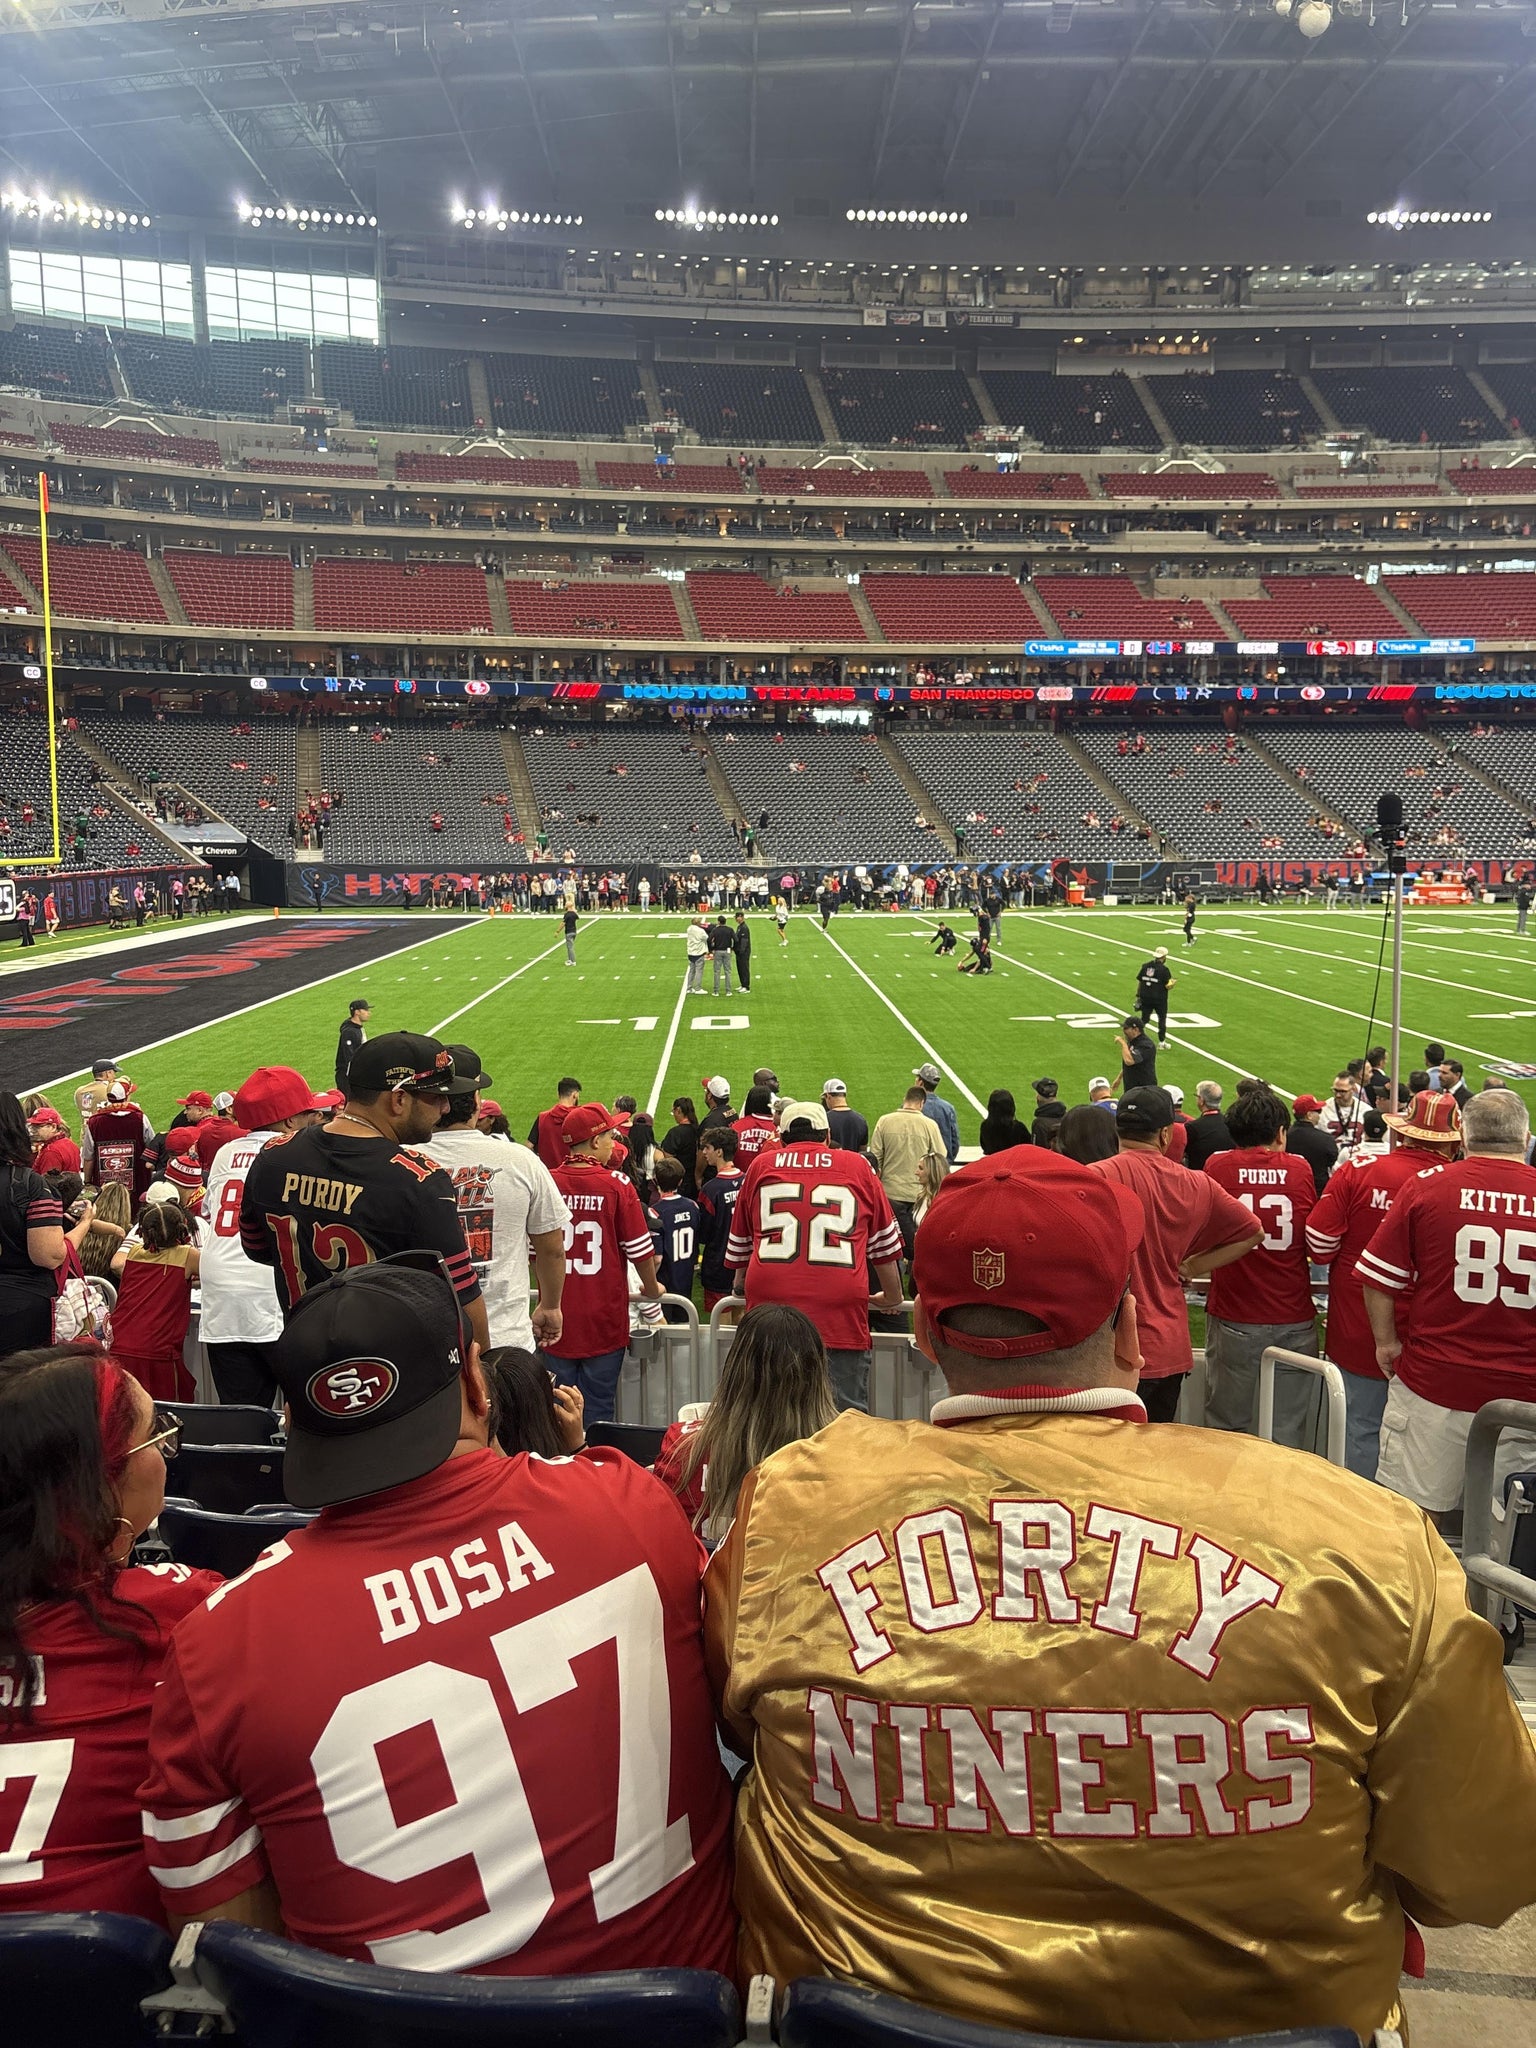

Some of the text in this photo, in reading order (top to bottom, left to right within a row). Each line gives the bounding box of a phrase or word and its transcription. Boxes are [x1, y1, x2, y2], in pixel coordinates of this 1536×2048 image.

[623, 685, 856, 700] HOUSTON TEXANS
[910, 688, 942, 700] SAN
[945, 688, 1035, 700] FRANCISCO
[1435, 685, 1536, 699] HOUSTO
[205, 846, 237, 855] Chevron
[231, 1152, 257, 1169] KIT
[740, 1141, 758, 1152] THE
[774, 1152, 833, 1169] WILLIS
[1238, 1167, 1288, 1185] PURDY
[214, 1179, 245, 1238] 8
[281, 1172, 364, 1216] PURDY
[757, 1183, 858, 1268] 52
[672, 1227, 694, 1262] 10
[976, 1266, 1001, 1284] NFL
[1453, 1224, 1536, 1310] 85
[327, 1367, 381, 1410] SF
[364, 1520, 555, 1645] BOSA
[816, 1498, 1284, 1681] FORTY
[309, 1561, 698, 1974] 97
[808, 1686, 1316, 1839] NINERS
